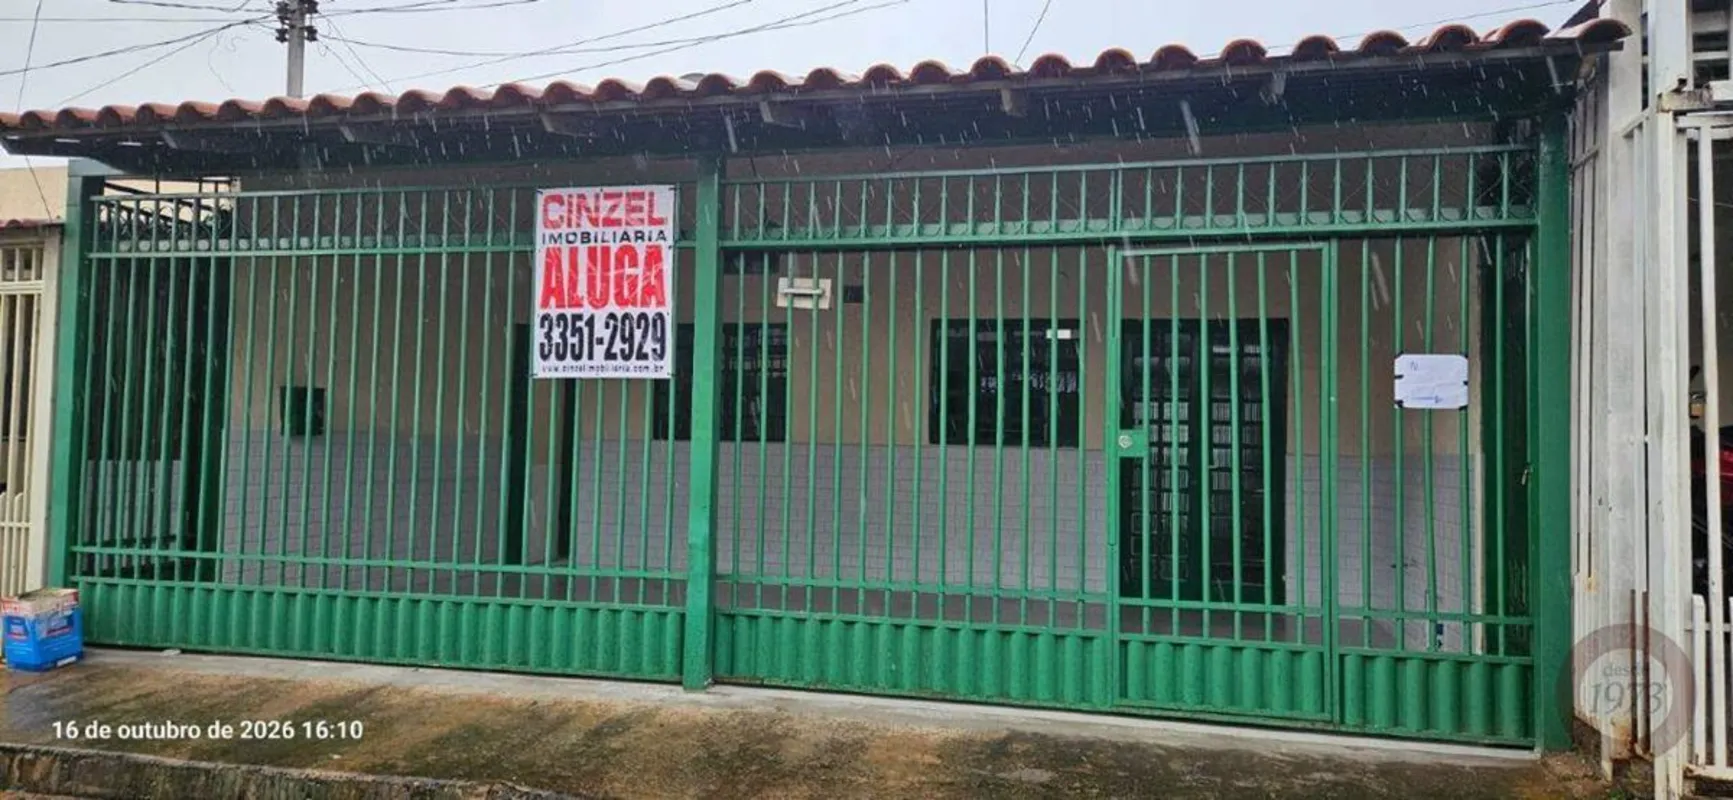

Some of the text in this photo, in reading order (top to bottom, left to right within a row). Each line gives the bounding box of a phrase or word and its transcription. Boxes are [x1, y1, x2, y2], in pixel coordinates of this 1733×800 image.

[542, 191, 668, 229] CINZEL
[540, 245, 666, 310] ALUGA
[539, 312, 667, 362] 3351-2929
